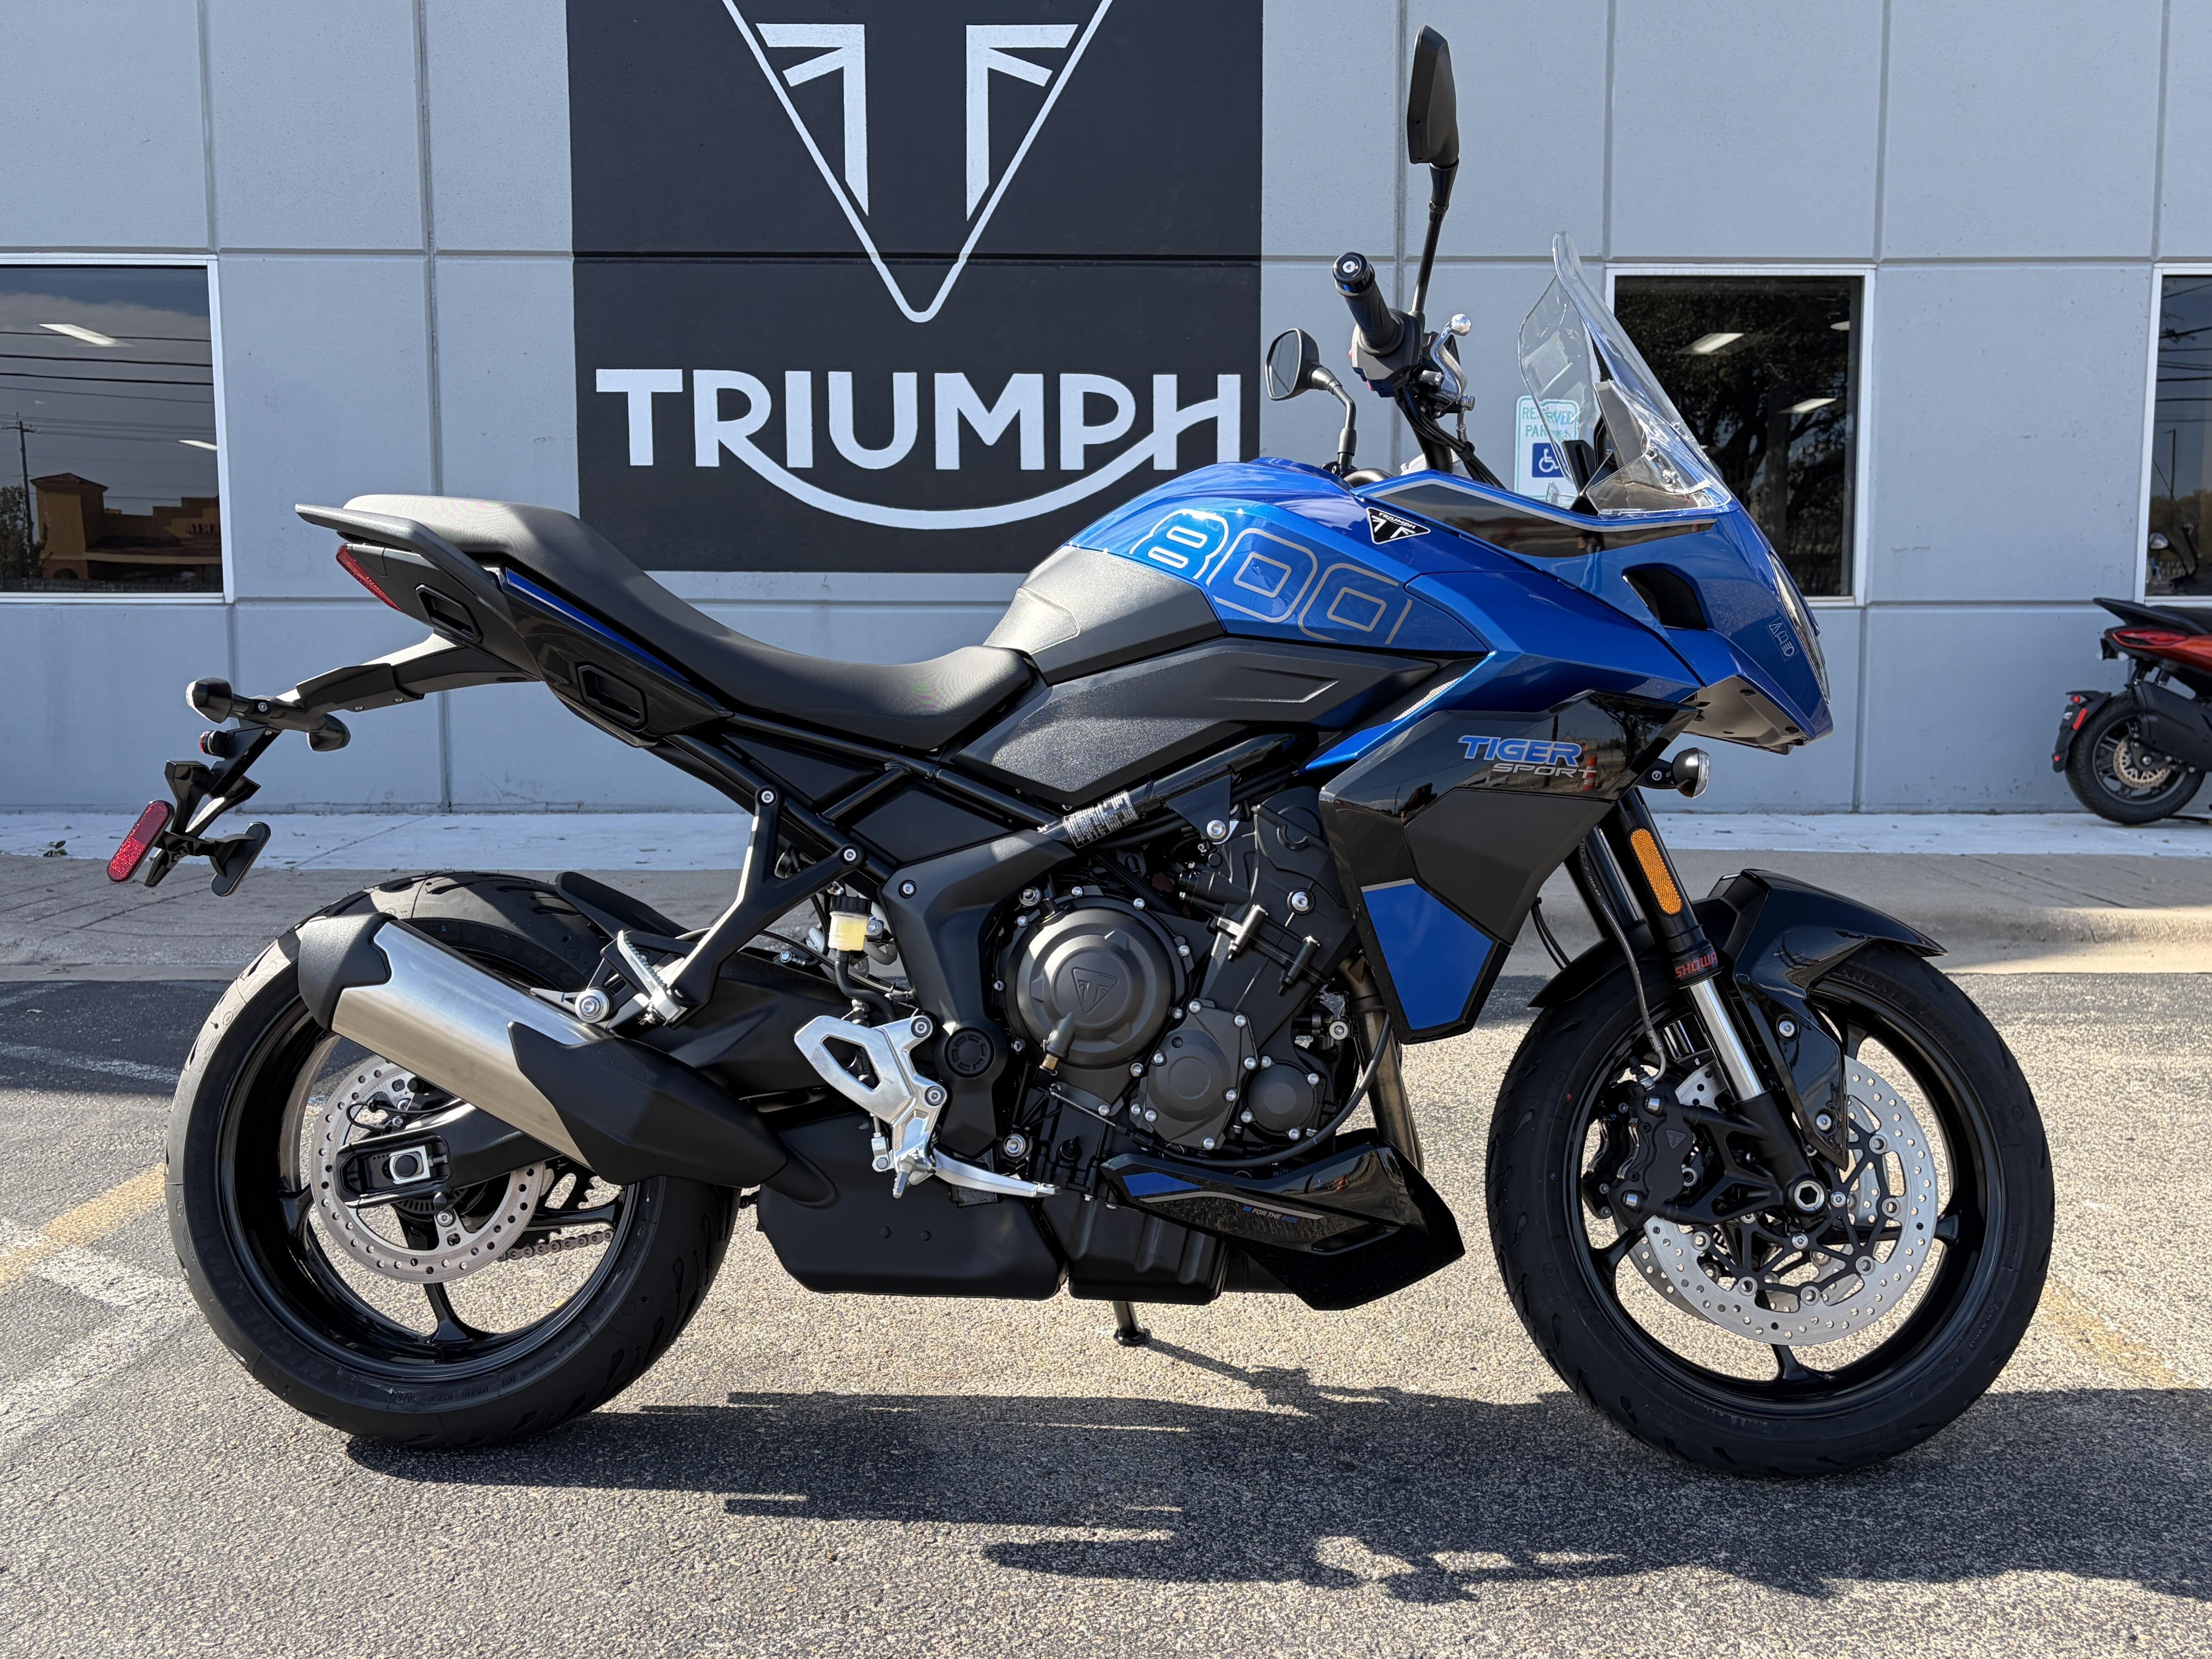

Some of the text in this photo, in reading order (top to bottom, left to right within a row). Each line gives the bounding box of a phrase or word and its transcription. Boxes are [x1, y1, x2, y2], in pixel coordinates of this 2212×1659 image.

[595, 369, 1241, 530] TRIUMPH
[1378, 512, 1416, 529] TRIUMPH
[1129, 508, 1413, 645] 800
[1457, 735, 1583, 768] TIGER
[1492, 763, 1597, 779] SPORT
[1675, 952, 1718, 979] SHOWA
[1252, 1208, 1299, 1224] FOR THE RIDE
